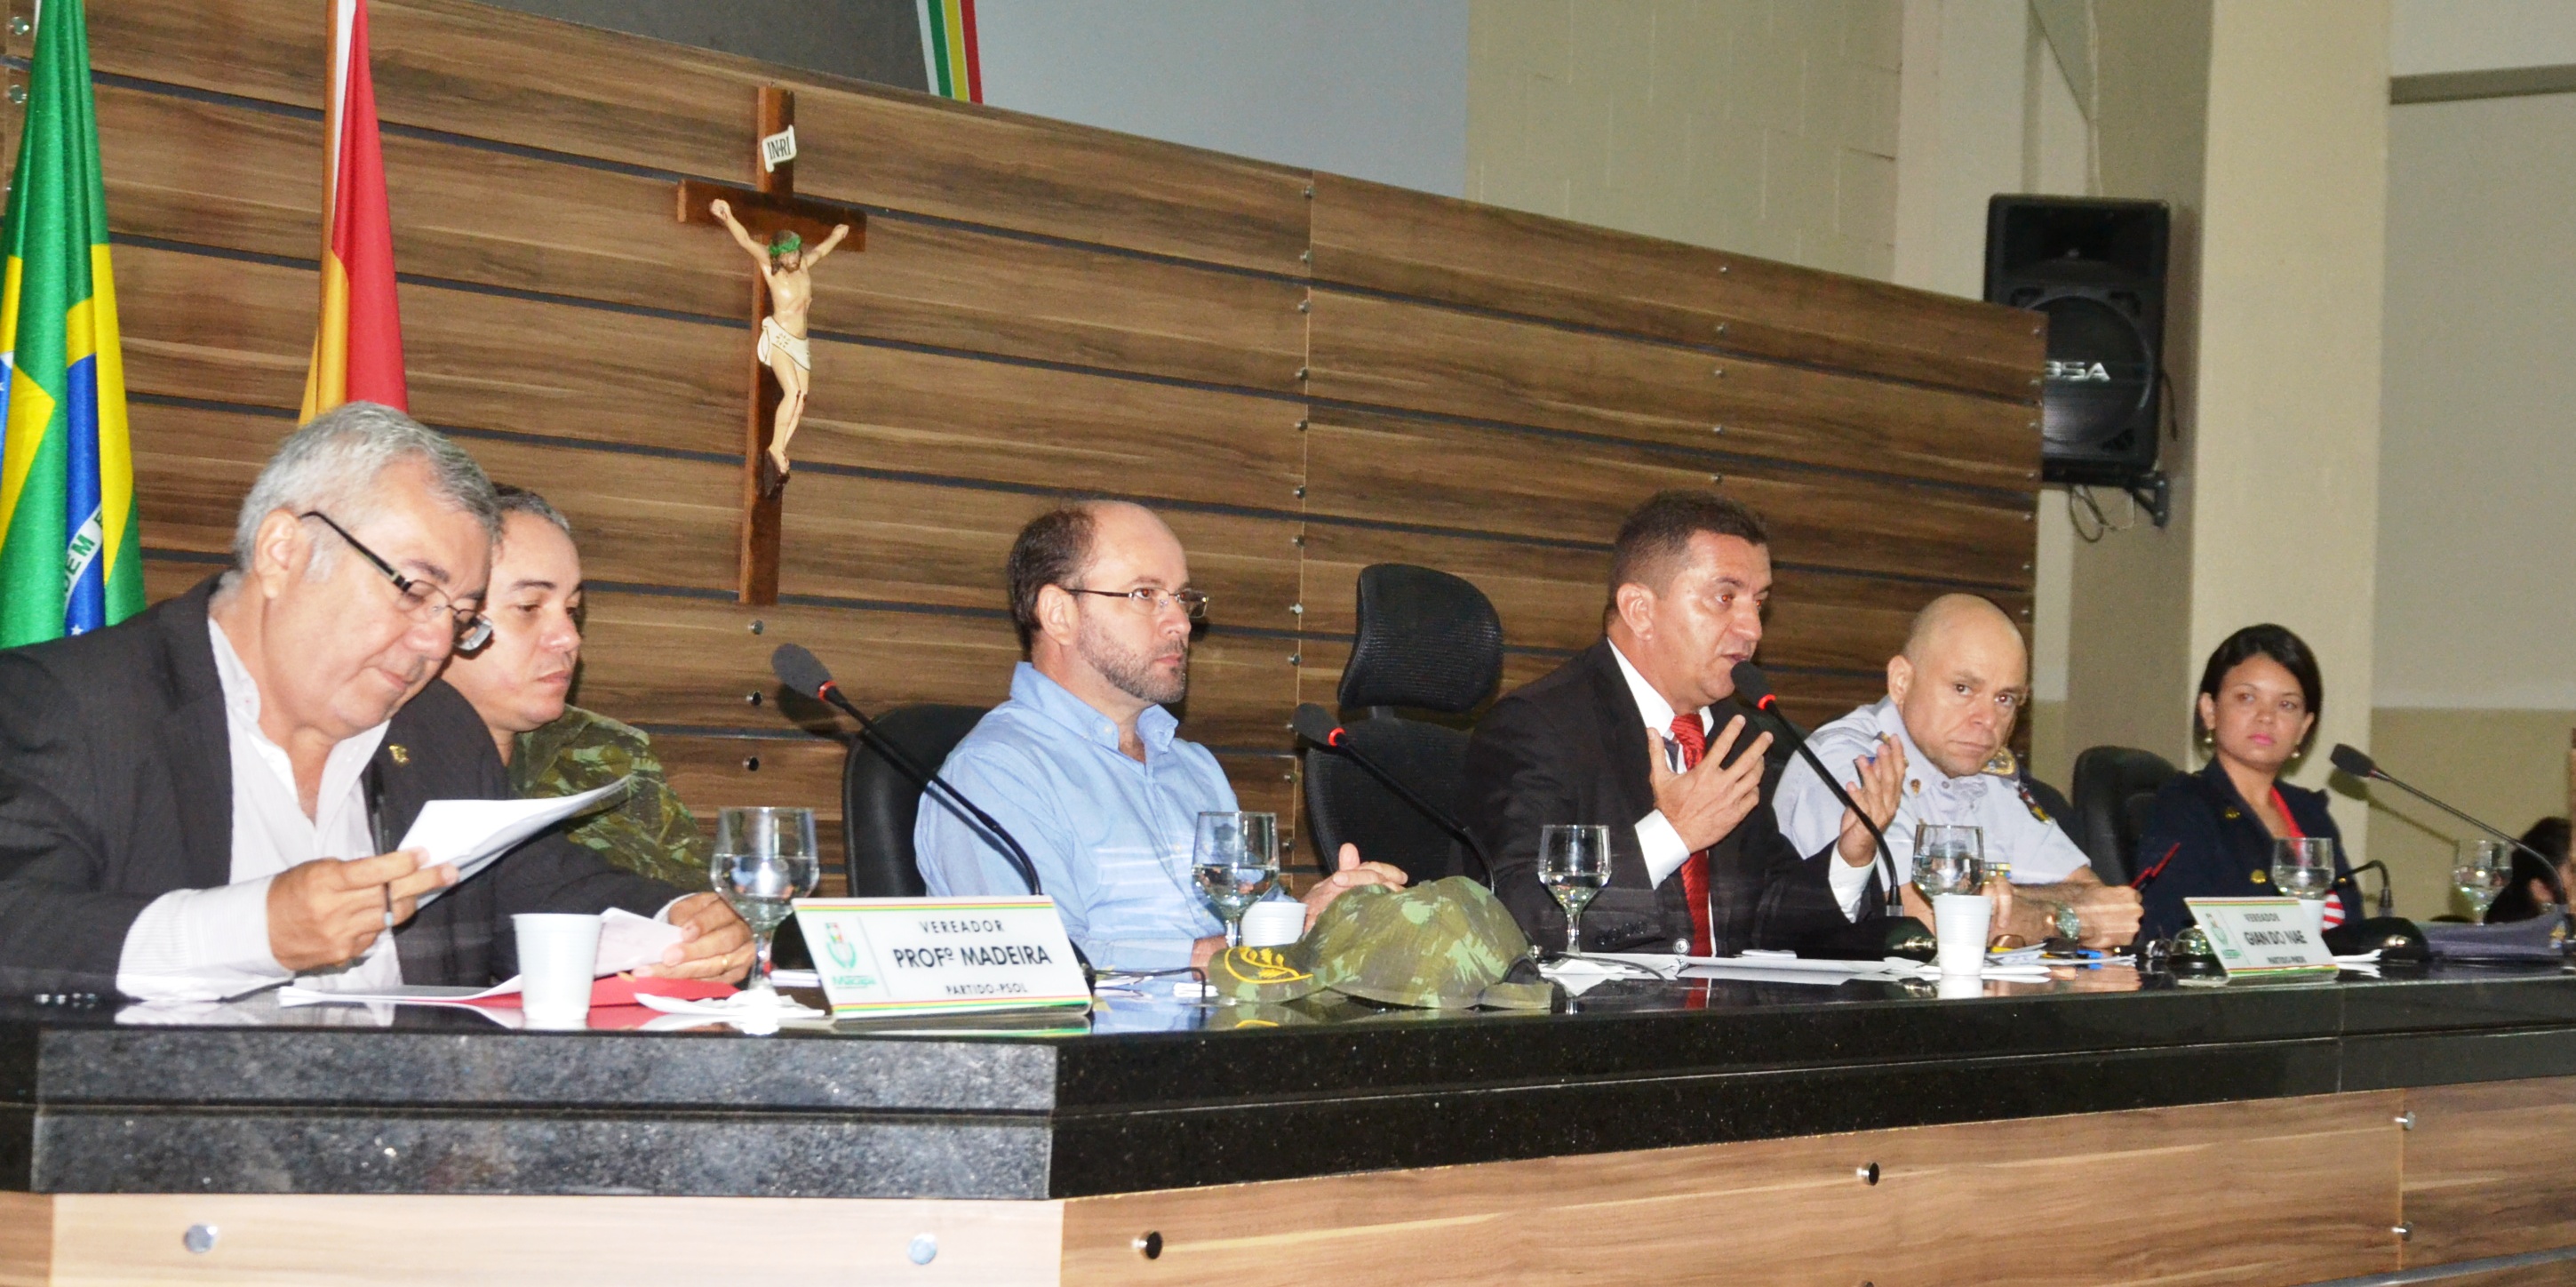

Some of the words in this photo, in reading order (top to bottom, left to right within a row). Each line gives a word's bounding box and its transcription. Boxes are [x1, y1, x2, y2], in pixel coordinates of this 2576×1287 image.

[920, 920, 1005, 933] VEREADOR
[961, 946, 1053, 966] MADEIRA
[945, 982, 1028, 995] PARTIDO-PSOL
